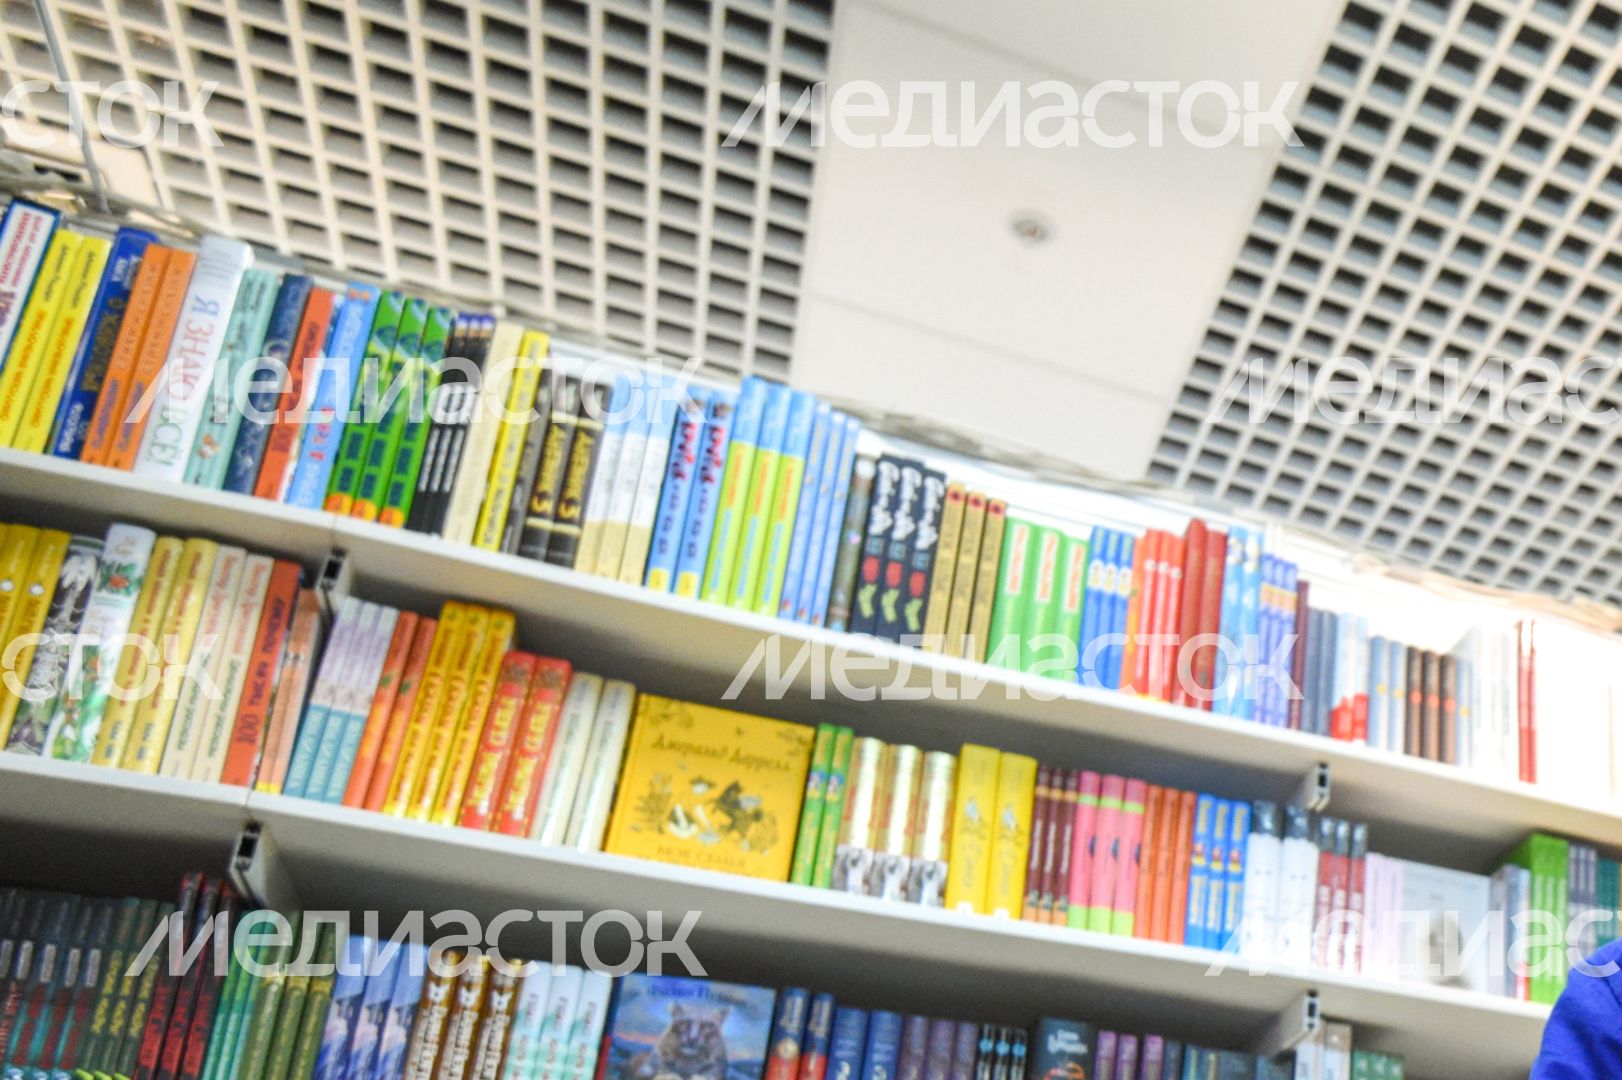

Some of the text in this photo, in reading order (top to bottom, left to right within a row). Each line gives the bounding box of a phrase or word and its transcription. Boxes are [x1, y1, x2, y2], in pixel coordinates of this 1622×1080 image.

[190, 295, 222, 316] Я
[165, 319, 215, 401] ЗНАЮ
[235, 713, 261, 744] 100
